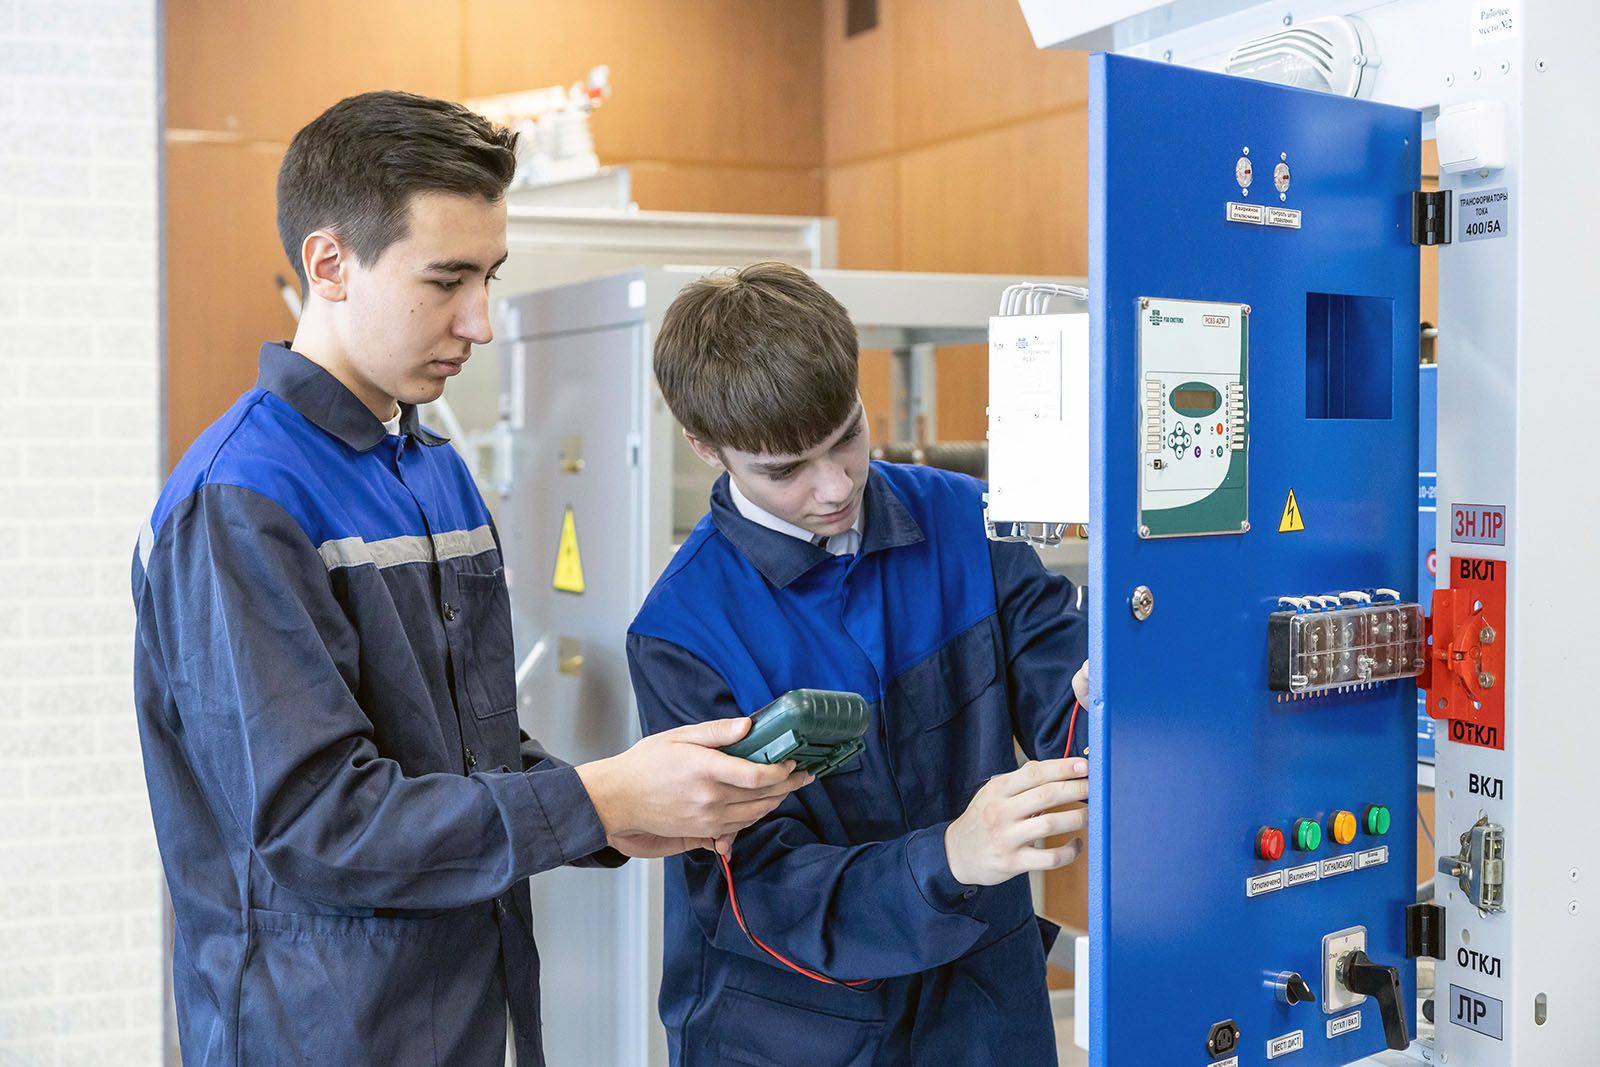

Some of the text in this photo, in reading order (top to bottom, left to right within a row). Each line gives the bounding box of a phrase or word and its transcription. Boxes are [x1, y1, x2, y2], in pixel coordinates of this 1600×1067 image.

[1460, 192, 1508, 207] ТРАНСФОРМАТОРЫ
[1234, 205, 1259, 213] Аварийное
[1475, 208, 1489, 216] ТОКА
[1418, 486, 1436, 498] 10-2
[1481, 511, 1503, 538] ЛР
[1460, 559, 1495, 581] ВКЛ
[1453, 720, 1497, 747] ОТКЛ
[1469, 773, 1503, 800] ВКЛ
[1323, 859, 1353, 873] СИГНАЛИЗАЦИЯ
[1289, 869, 1317, 882] Включено
[1252, 878, 1281, 891] Отключено
[1457, 948, 1501, 978] ОТКЛ
[1457, 994, 1487, 1025] ЛР
